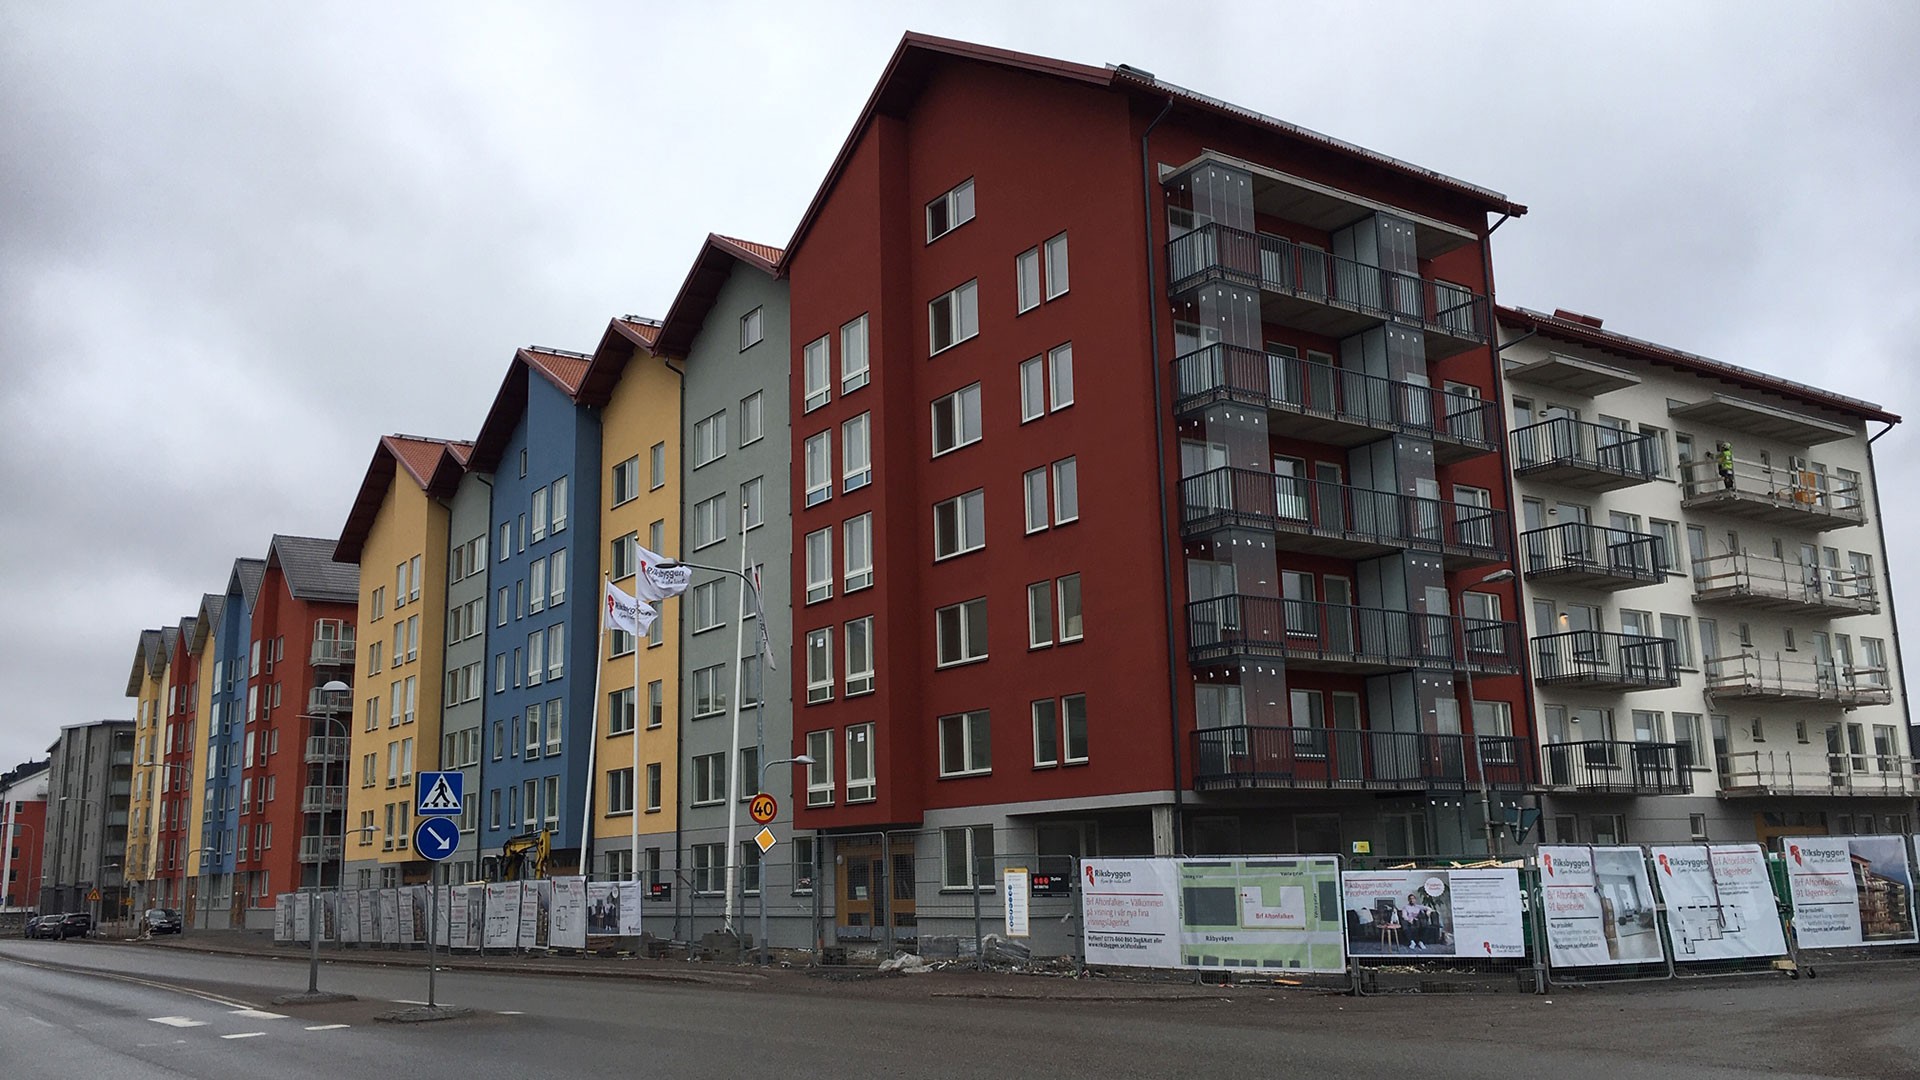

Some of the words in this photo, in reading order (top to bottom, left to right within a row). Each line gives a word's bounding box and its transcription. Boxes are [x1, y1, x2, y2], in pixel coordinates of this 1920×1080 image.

[754, 801, 773, 816] 40
[1801, 849, 1844, 858] Riksbyggen
[1553, 858, 1590, 869] Riksbyggen
[1670, 857, 1708, 868] Riksbyggen
[1095, 869, 1131, 879] Riksbyggen
